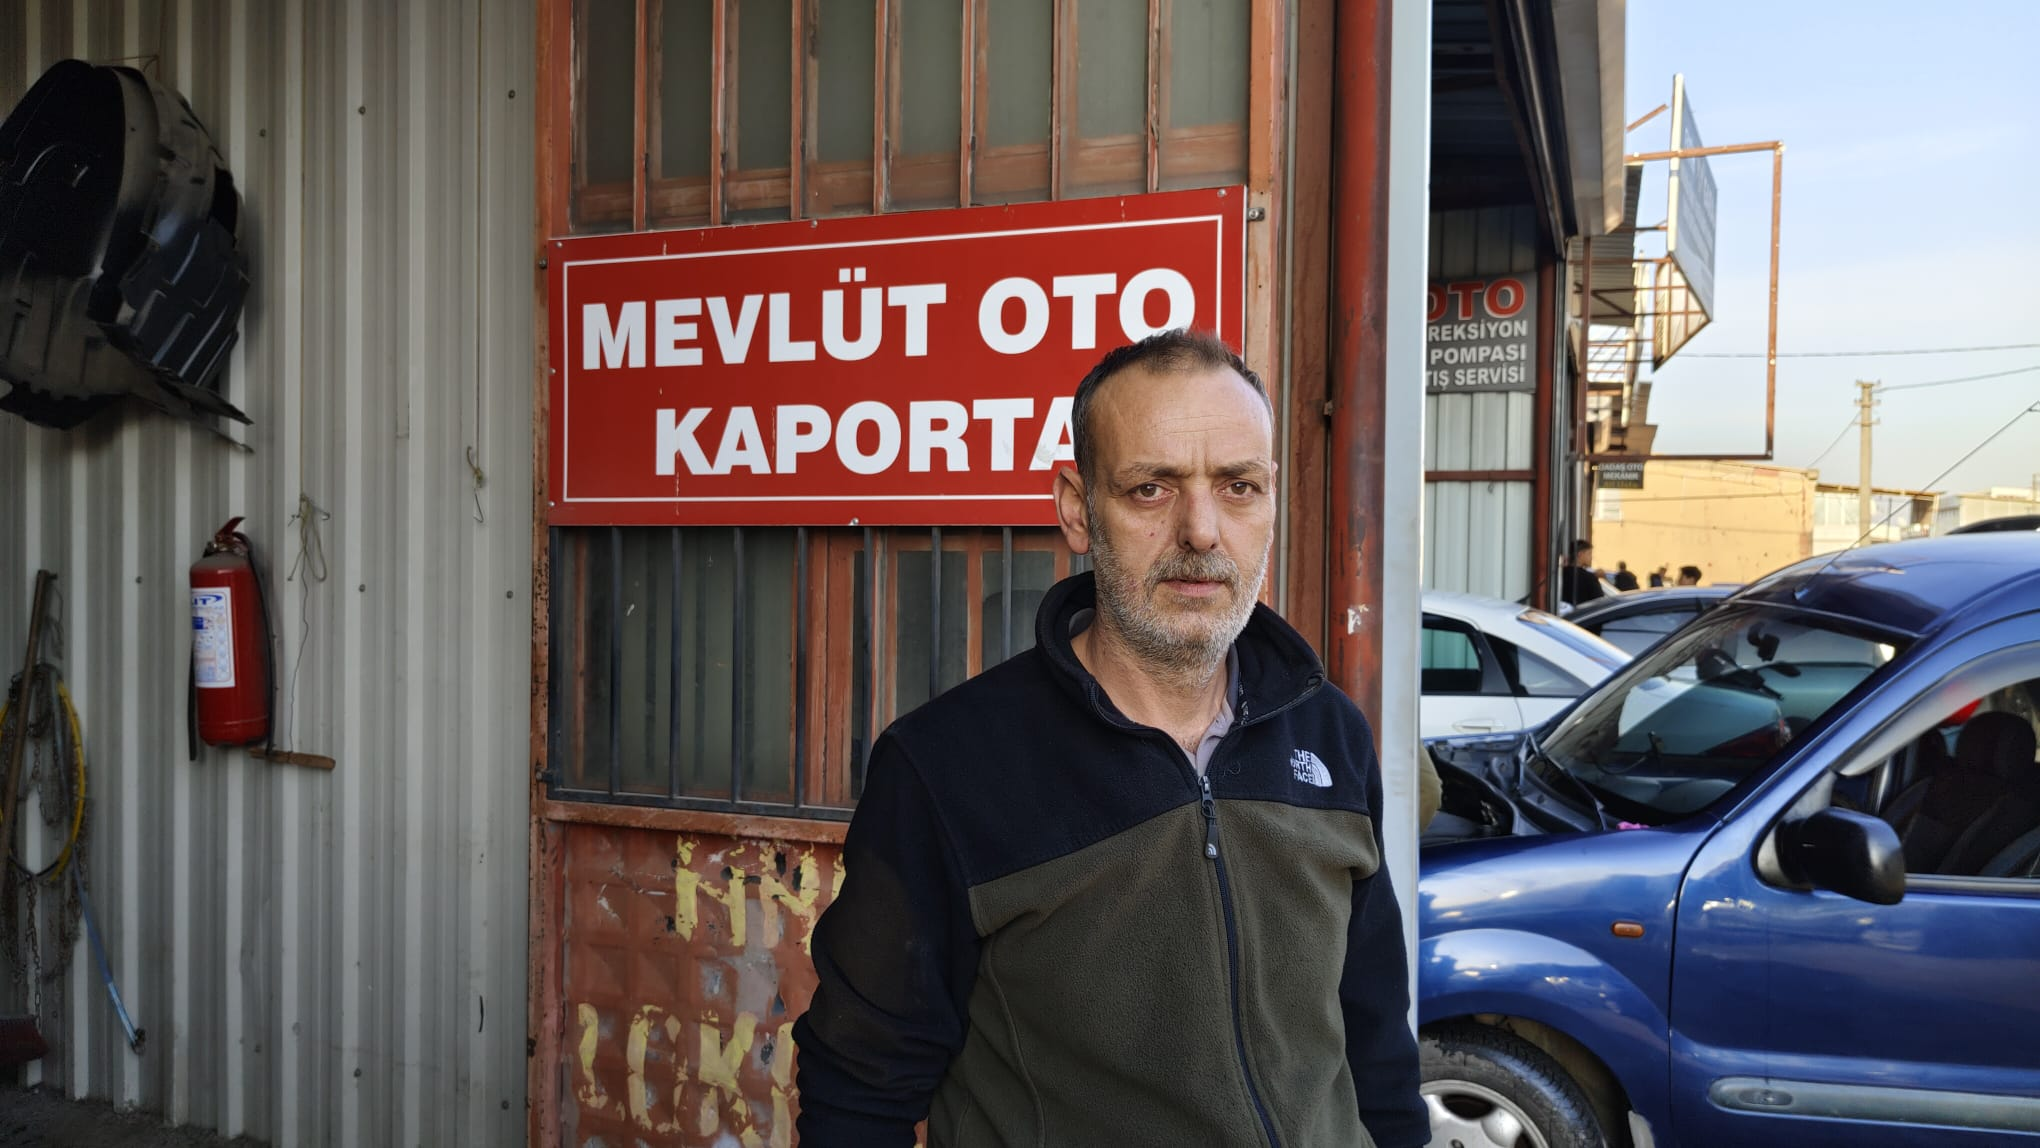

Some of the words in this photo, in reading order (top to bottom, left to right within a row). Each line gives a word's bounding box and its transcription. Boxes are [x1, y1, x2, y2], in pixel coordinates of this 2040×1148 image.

[582, 266, 947, 370] MEVLÜT
[978, 267, 1196, 355] OTO
[1430, 343, 1528, 365] POMPASI
[1454, 361, 1526, 386] SERVİSİ
[656, 396, 1077, 476] KAPORTA
[1294, 749, 1311, 762] THE
[1293, 768, 1314, 785] FACE
